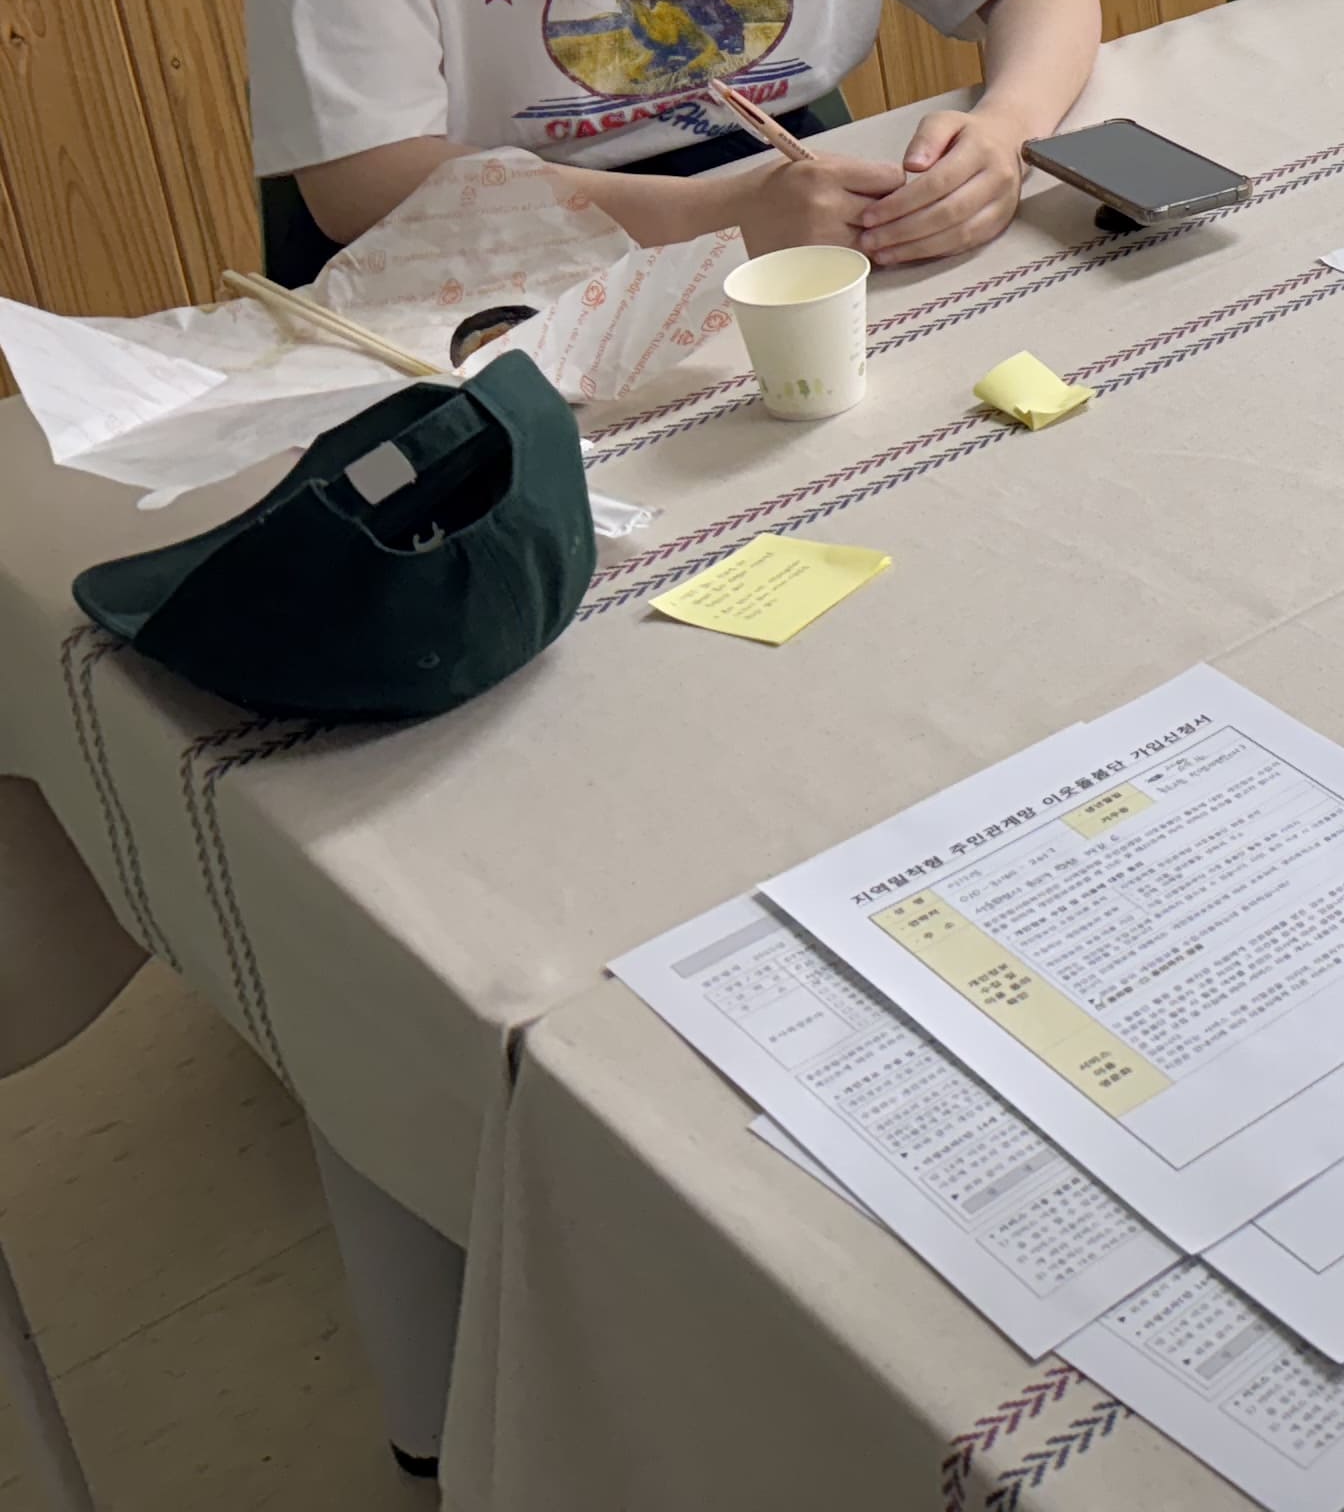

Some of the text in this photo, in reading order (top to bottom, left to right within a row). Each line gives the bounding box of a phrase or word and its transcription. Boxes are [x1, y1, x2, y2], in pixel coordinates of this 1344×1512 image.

[660, 281, 697, 333] recherche
[851, 855, 944, 907] 지역밀착형
[949, 806, 1037, 856] 주민관계망
[1045, 759, 1122, 807] 이웃돌봄단
[1134, 714, 1208, 760] 가입신청서
[967, 962, 1009, 987] 개인정보
[1077, 1049, 1112, 1070] 서비스
